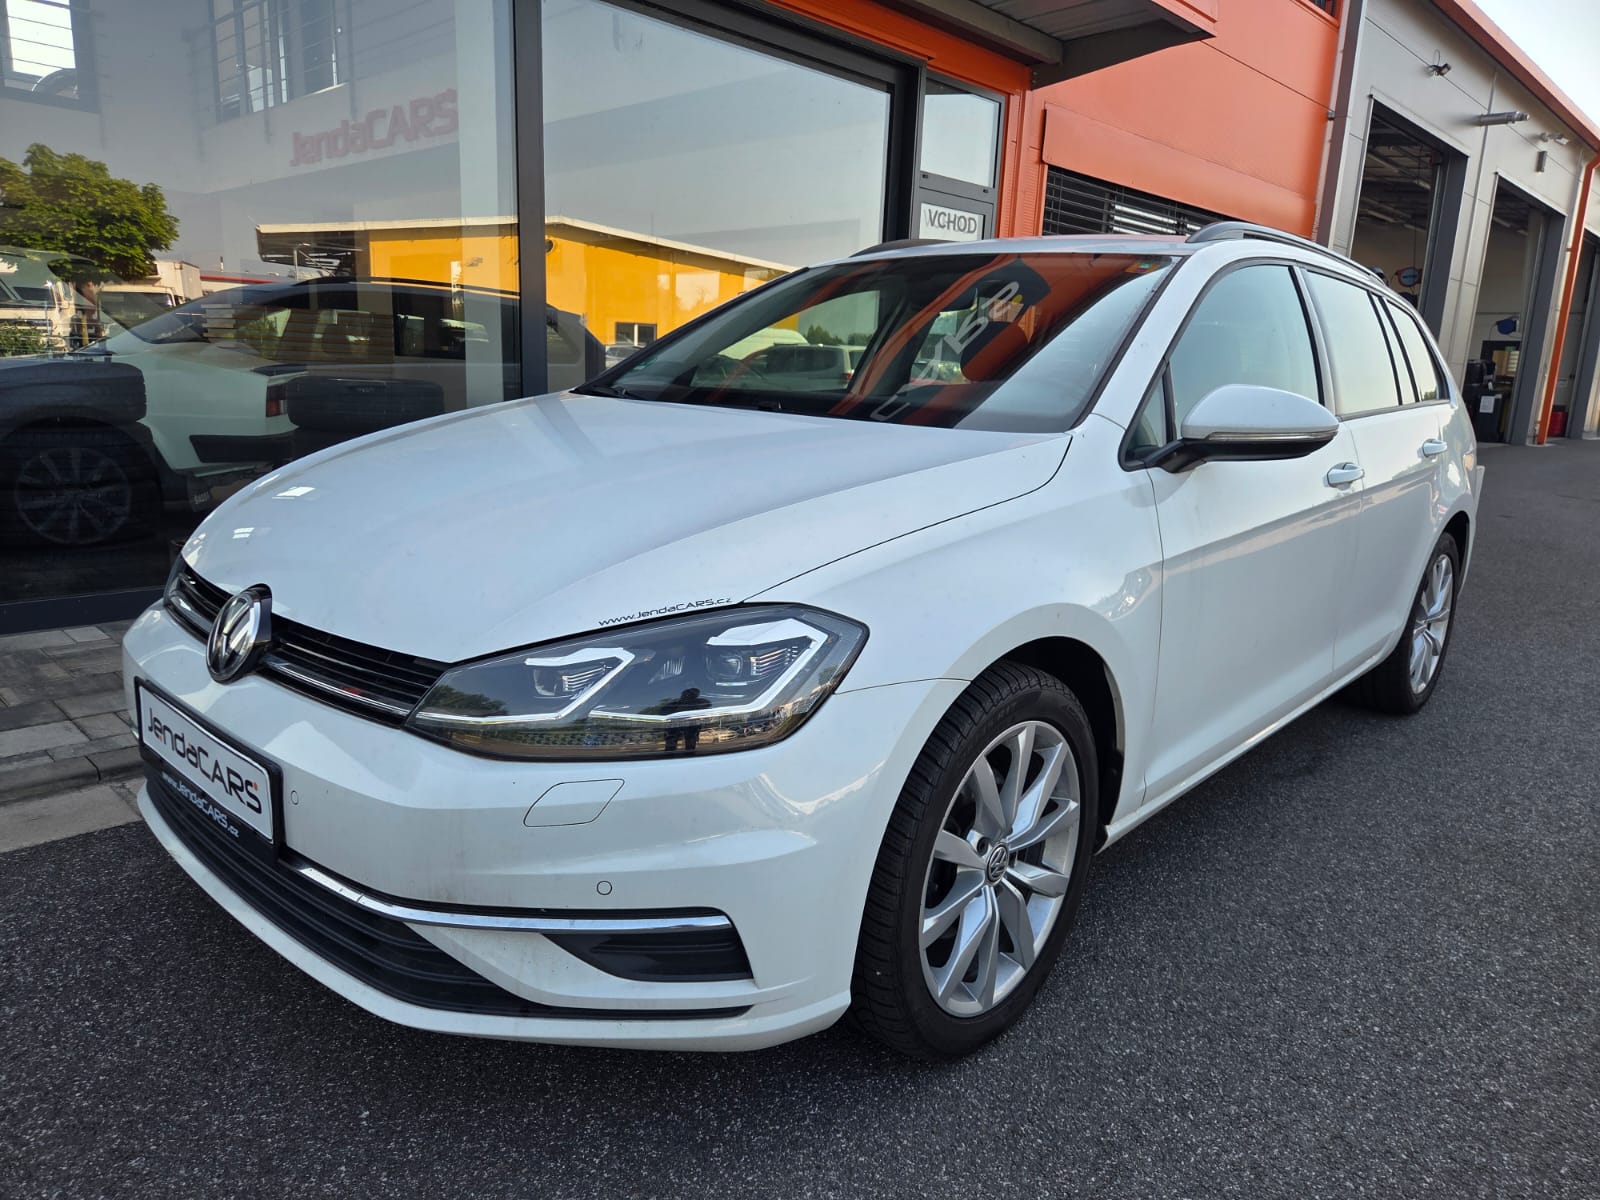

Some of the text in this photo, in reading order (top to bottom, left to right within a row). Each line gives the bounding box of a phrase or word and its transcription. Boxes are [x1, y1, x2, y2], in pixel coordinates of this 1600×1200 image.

[289, 88, 458, 167] JendaCARS
[928, 208, 977, 234] VCHOD
[598, 597, 732, 626] www.JendaCARS.cz
[147, 707, 263, 814] JendaCARS
